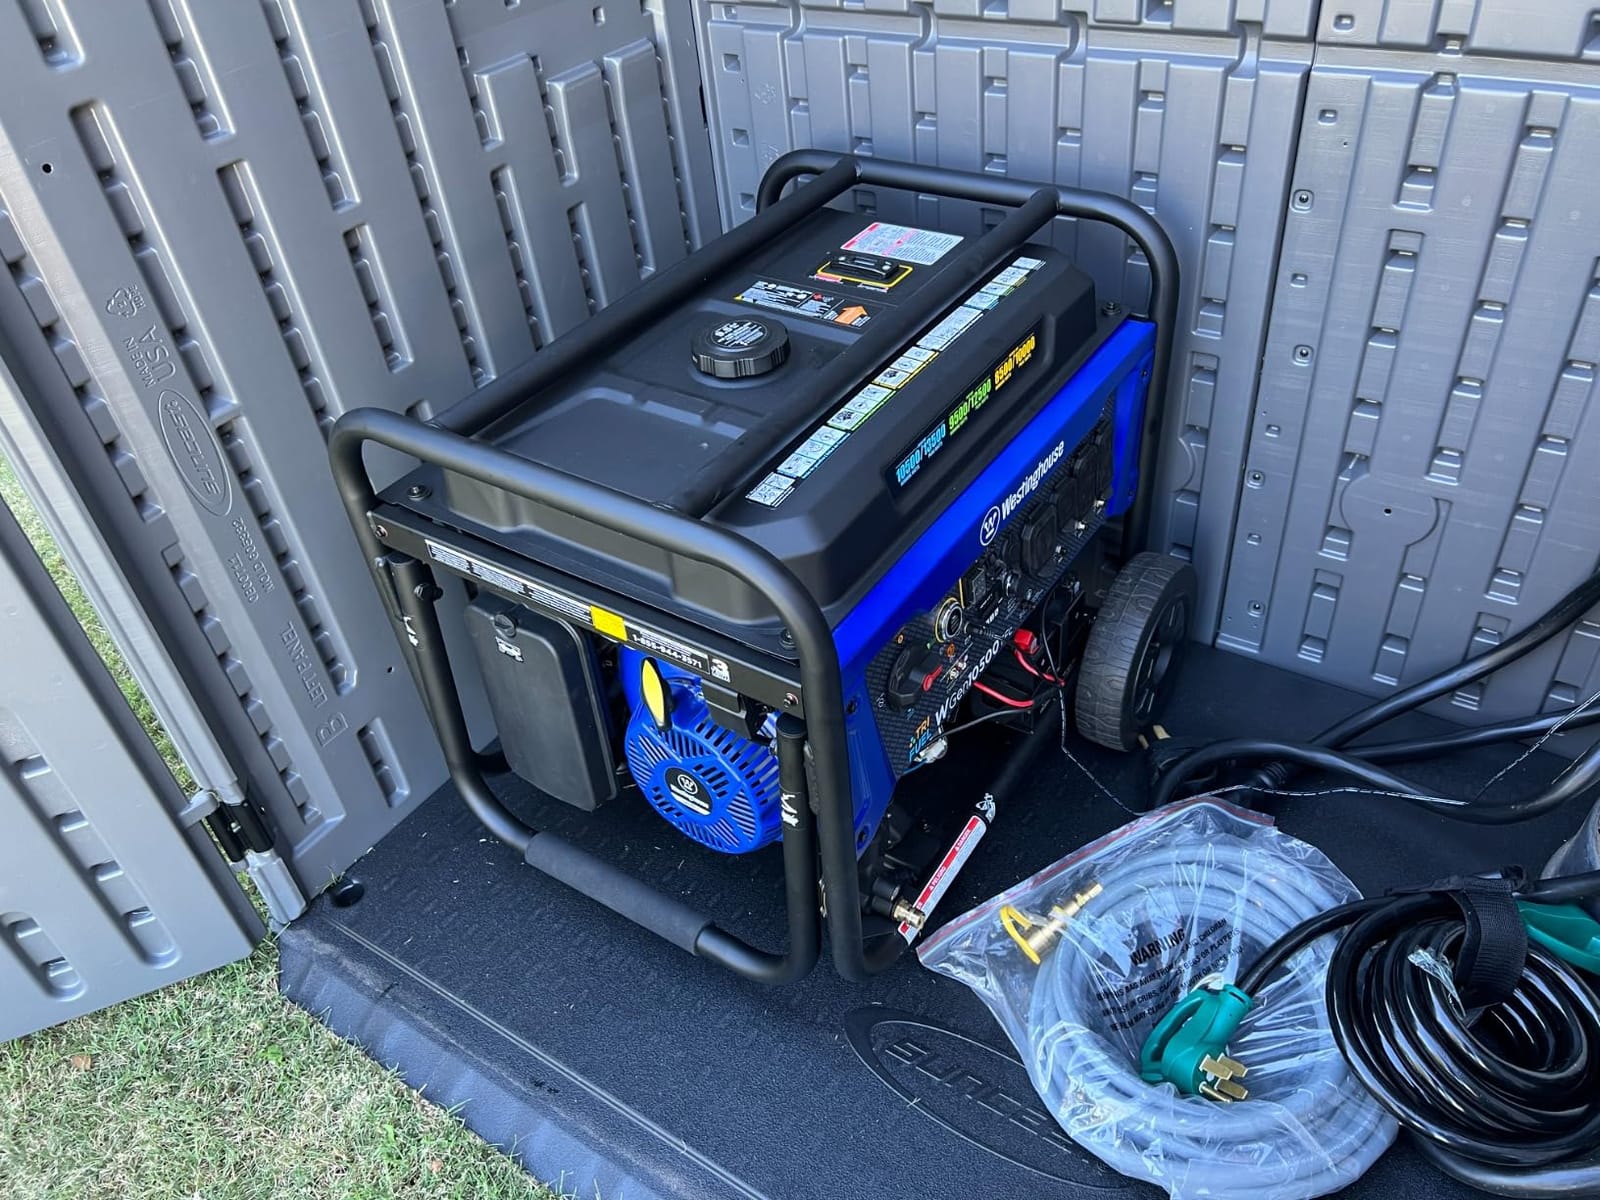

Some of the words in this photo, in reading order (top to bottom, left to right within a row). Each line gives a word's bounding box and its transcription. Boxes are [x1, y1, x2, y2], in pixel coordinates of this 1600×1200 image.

[124, 336, 140, 352] IN
[140, 323, 176, 382] USA
[131, 352, 157, 389] MADE
[1001, 440, 1065, 521] Westinghouse
[254, 561, 275, 593] MOLD
[281, 620, 312, 675] PANEL
[301, 672, 329, 711] LEFT
[315, 711, 349, 748] B
[915, 715, 930, 739] TRI
[909, 729, 933, 763] FUEL
[1130, 928, 1185, 967] WARNING
[1199, 917, 1228, 942] CHILDREN
[885, 1039, 1089, 1164] SUNCAS
